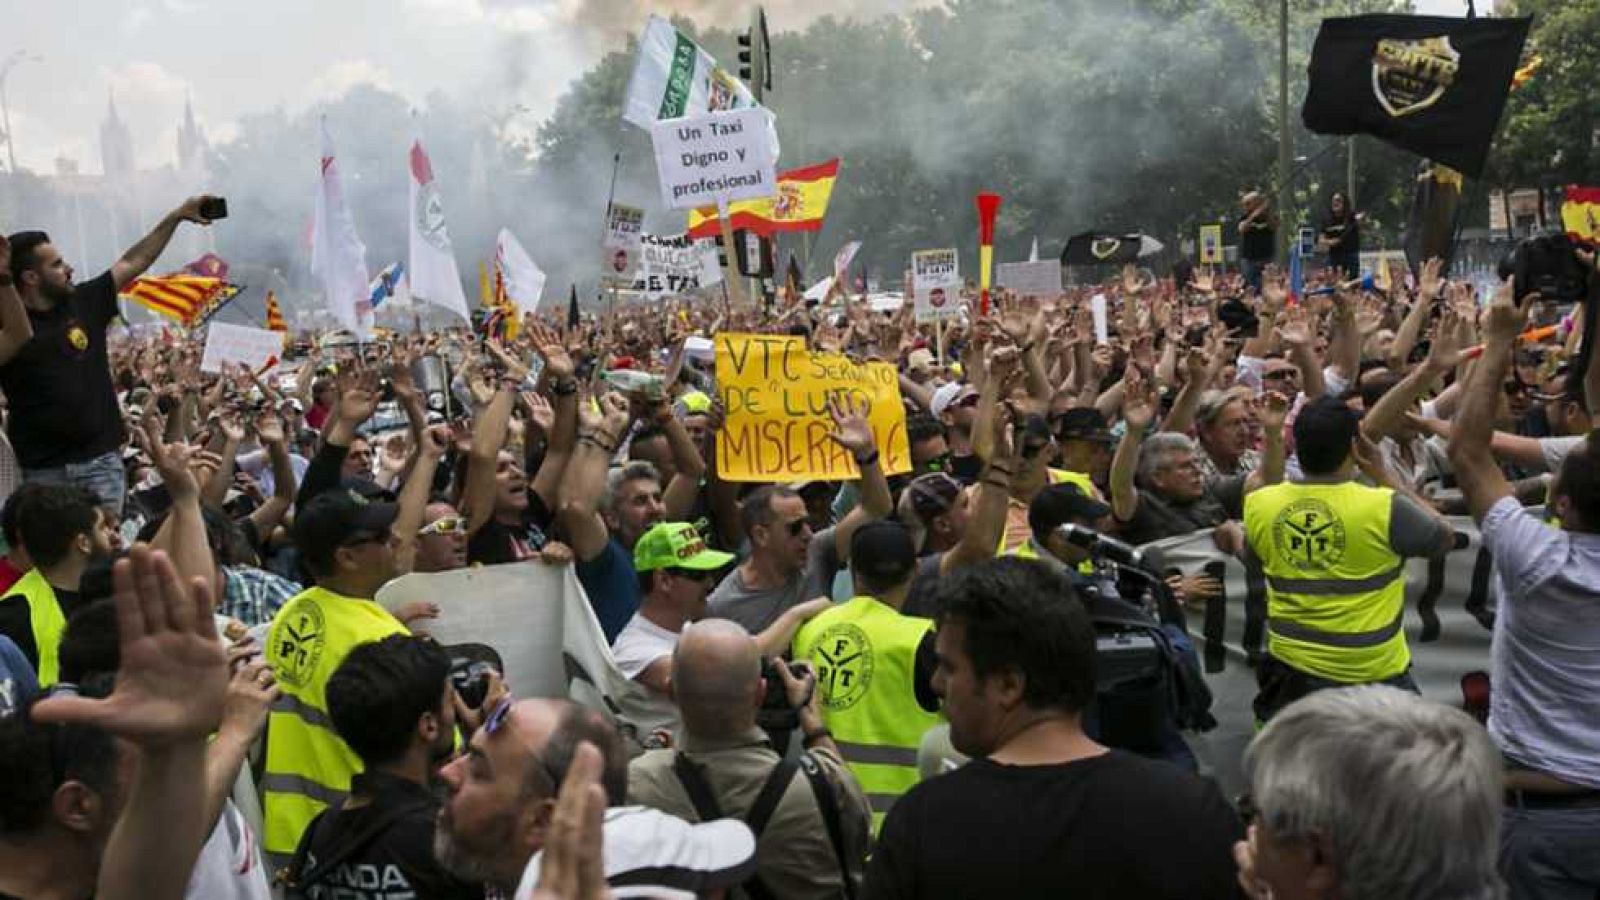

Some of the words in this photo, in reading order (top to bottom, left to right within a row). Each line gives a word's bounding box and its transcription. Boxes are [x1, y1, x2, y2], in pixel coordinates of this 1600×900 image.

[678, 126, 702, 142] Un
[709, 118, 744, 137] Taxi
[681, 150, 729, 168] Digno
[736, 148, 746, 164] y
[673, 169, 762, 199] profesional
[725, 337, 800, 382] VTC
[724, 385, 767, 416] DE
[722, 419, 901, 475] MISERAE
[1305, 513, 1317, 528] F
[1292, 536, 1303, 549] P
[1316, 537, 1328, 551] T
[281, 641, 295, 657] P
[833, 639, 849, 656] F
[818, 666, 828, 682] P
[841, 669, 854, 687] T
